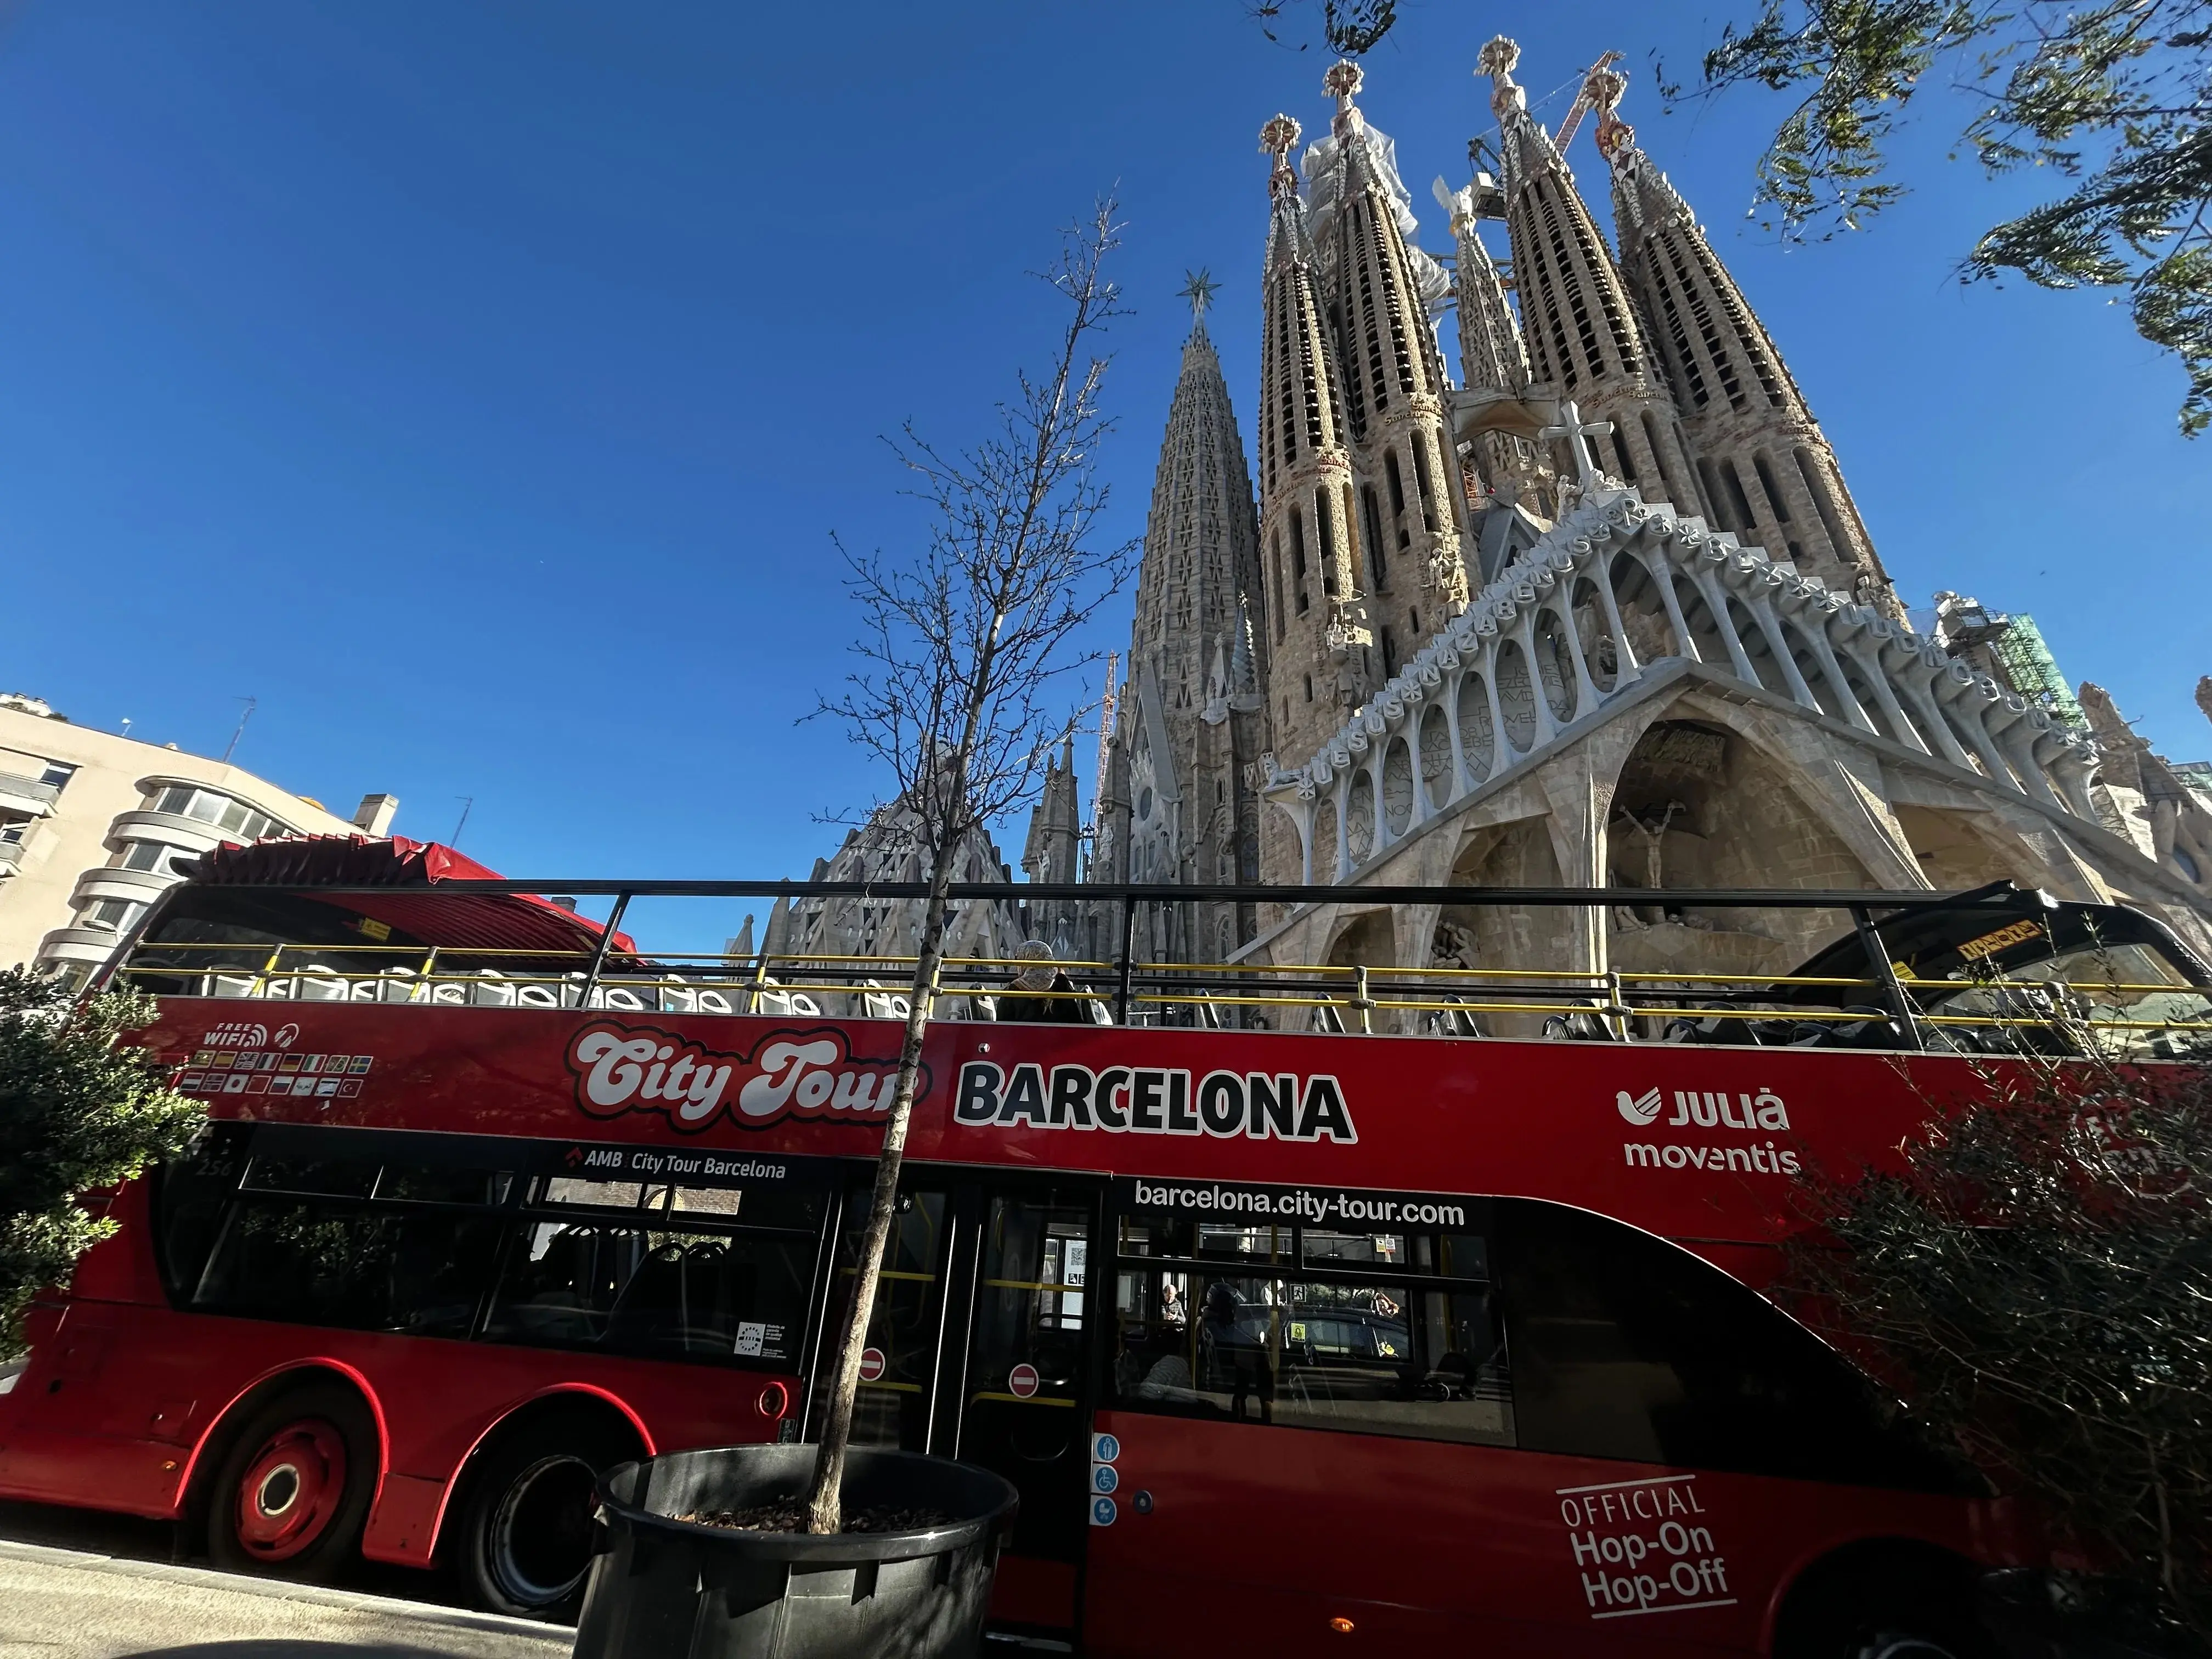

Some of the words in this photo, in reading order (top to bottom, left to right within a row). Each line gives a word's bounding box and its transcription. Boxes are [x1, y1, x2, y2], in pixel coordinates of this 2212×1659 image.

[204, 1032, 246, 1046] WIFI
[577, 1032, 732, 1120] City
[955, 1061, 1357, 1144] BARCELONA
[195, 1159, 234, 1176] 256
[585, 1150, 622, 1168] AMB
[632, 1153, 663, 1173] City
[667, 1157, 701, 1173] Tour
[704, 1159, 786, 1179] Barcelona
[1624, 1141, 1801, 1174] moventis
[1135, 1180, 1464, 1226] barcelona.city-tour.com
[1561, 1486, 1705, 1527] OFFICIAL
[1570, 1521, 1714, 1569] Hop-On
[1582, 1558, 1728, 1610] Hop-Off
